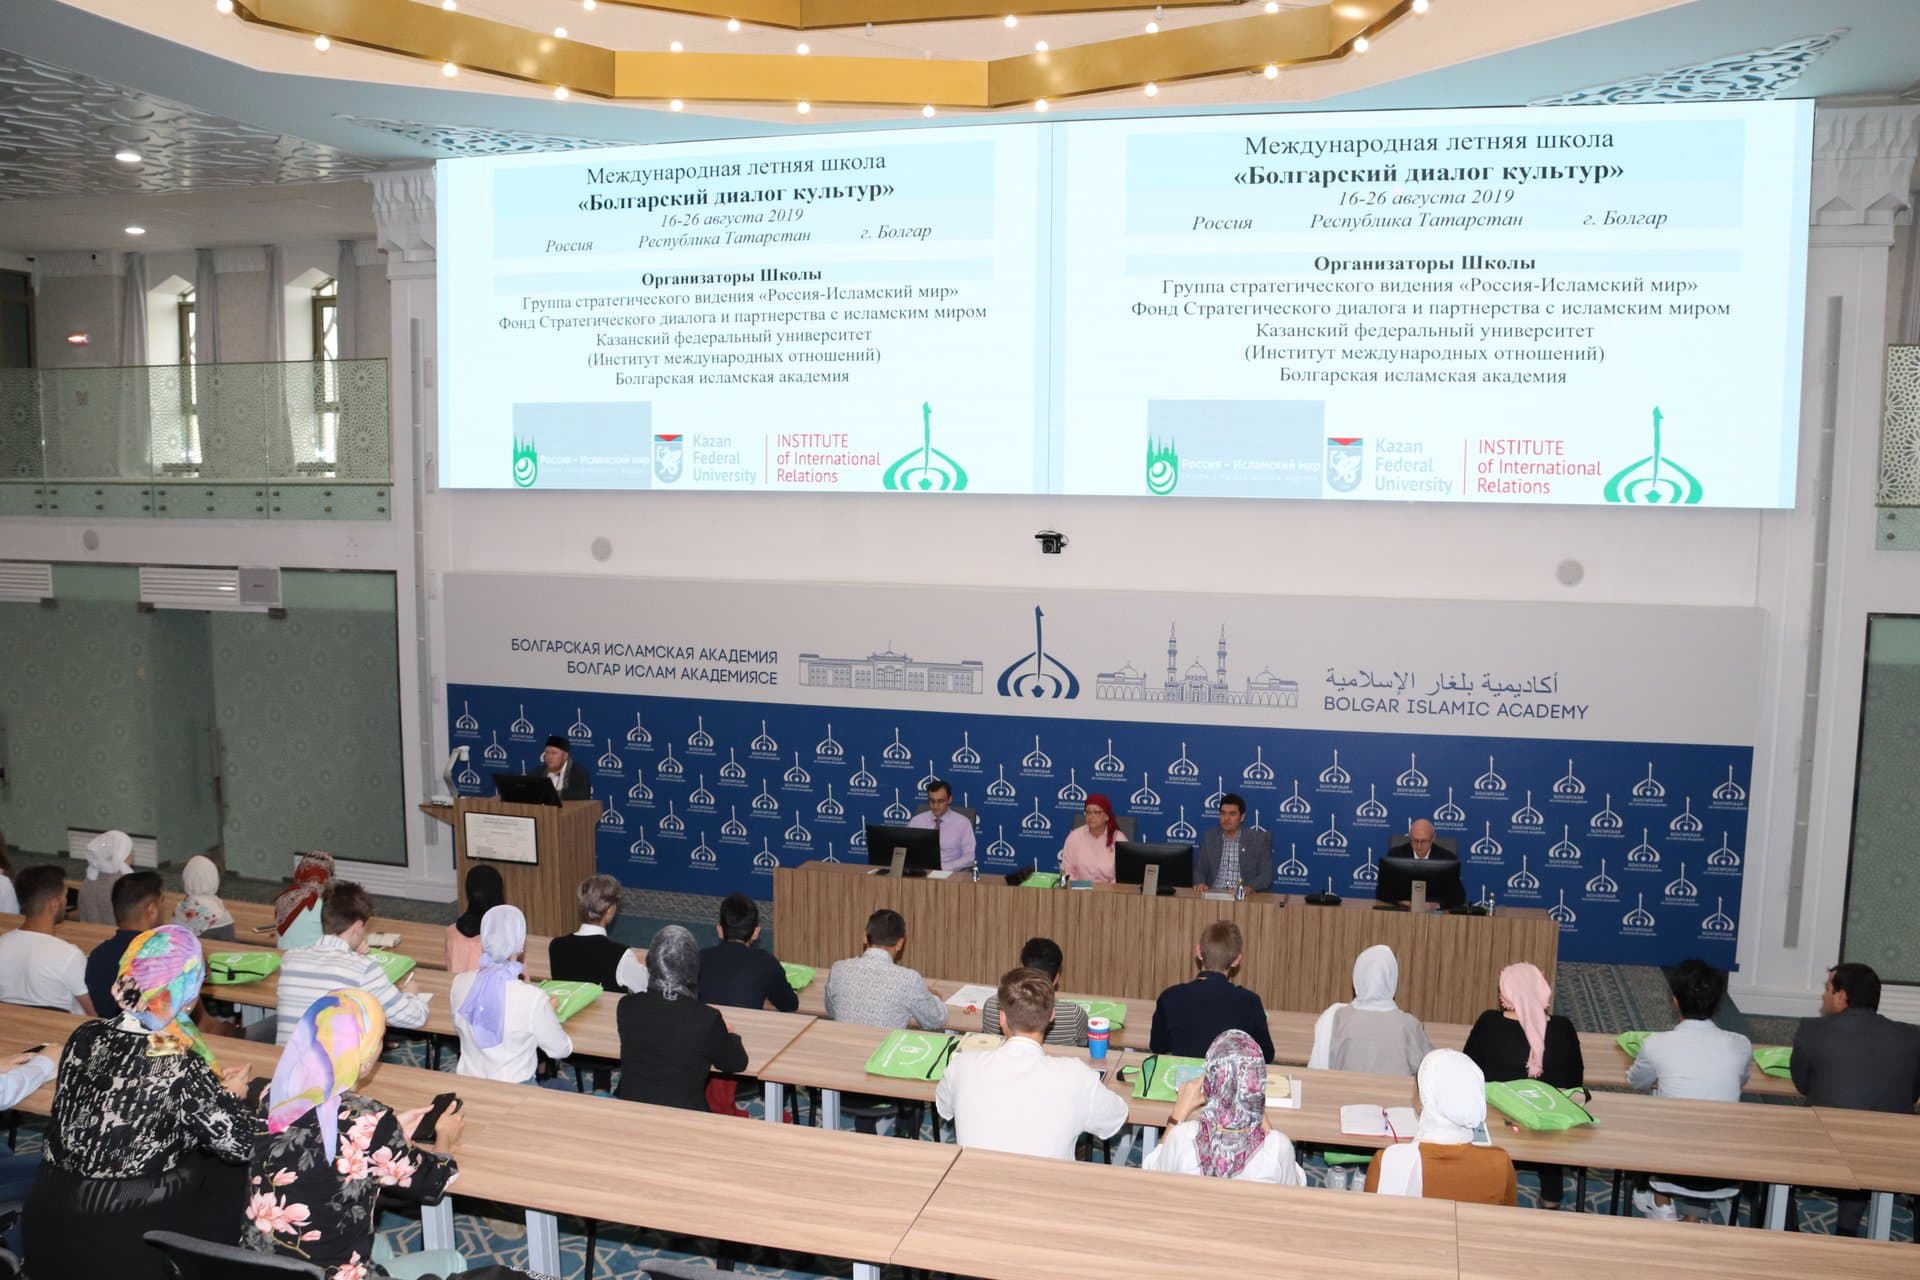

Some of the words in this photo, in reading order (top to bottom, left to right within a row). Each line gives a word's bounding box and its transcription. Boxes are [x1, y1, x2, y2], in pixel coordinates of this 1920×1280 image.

[1245, 136, 1438, 158] Международная
[1446, 134, 1527, 151] летняя
[1536, 133, 1615, 149] школа
[586, 164, 741, 185] Международная
[747, 159, 814, 175] летняя
[821, 155, 886, 172] школа
[1233, 164, 1397, 188] «Болгарский
[1405, 166, 1494, 183] диалог
[1502, 164, 1625, 184] культур»
[578, 189, 708, 212] «Болгарский
[714, 188, 786, 206] диалог
[793, 183, 895, 204] культур»
[1338, 191, 1387, 206] 16-26
[1392, 191, 1466, 208] августа
[1471, 189, 1515, 205] 2019
[660, 213, 700, 228] 16-26
[703, 212, 764, 228] августа
[768, 208, 804, 223] 2019
[1192, 216, 1253, 230] Россия
[1310, 213, 1412, 232] Республика
[1418, 212, 1523, 231] Татарстан
[1583, 214, 1596, 226] г.
[1603, 210, 1668, 229] Болгар
[545, 240, 594, 253] Россия
[638, 232, 720, 250] Республика
[725, 230, 811, 247] Татарстан
[860, 227, 873, 240] г.
[878, 225, 932, 240] Болгар
[1314, 256, 1454, 274] Организаторы
[1461, 255, 1536, 270] Школы
[642, 271, 755, 287] Организаторы
[760, 269, 822, 282] Школы
[1162, 280, 1224, 297] Группа
[1230, 281, 1374, 297] стратегического
[1380, 281, 1453, 293] видения
[1460, 277, 1644, 293] «Россия-Исламский
[1650, 279, 1698, 296] мир»
[523, 297, 572, 312] Группа
[575, 294, 690, 310] стратегического
[695, 292, 754, 304] видения
[760, 285, 913, 302] «Россия-Исламский
[918, 286, 959, 302] мир»
[498, 317, 535, 330] Фонд
[539, 314, 656, 331] Стратегического
[660, 314, 716, 327] диалога
[721, 313, 730, 323] и
[735, 310, 826, 326] партнерства
[830, 311, 838, 321] с
[844, 308, 929, 320] исламским
[934, 307, 987, 322] миром
[1131, 301, 1178, 317] Фонд
[1183, 301, 1332, 319] Стратегического
[1336, 303, 1407, 316] диалога
[1412, 304, 1423, 315] и
[1429, 303, 1540, 319] партнерства
[1545, 304, 1555, 315] с
[1561, 303, 1662, 315] исламским
[1669, 303, 1731, 319] миром
[596, 331, 670, 347] Казанский
[674, 330, 772, 348] федеральный
[776, 329, 873, 346] университет
[1256, 322, 1348, 338] Казанский
[1354, 323, 1474, 341] федеральный
[1480, 325, 1595, 341] университет
[588, 352, 660, 368] (Институт
[664, 351, 784, 367] международных
[788, 348, 881, 364] отношений)
[1245, 345, 1335, 363] (Институт
[1341, 348, 1488, 364] международных
[1494, 345, 1605, 364] отношений)
[615, 372, 695, 387] Болгарская
[699, 371, 774, 385] исламская
[779, 370, 849, 384] академия
[1280, 368, 1378, 386] Болгарская
[1384, 370, 1476, 383] исламская
[1482, 370, 1567, 384] академия
[693, 434, 732, 448] Kazan
[777, 433, 849, 448] INSTITUTE
[1376, 437, 1423, 454] Kazan
[1479, 438, 1564, 456] INSTITUTE
[693, 451, 741, 465] Federal
[777, 450, 791, 465] of
[794, 451, 881, 466] International
[1376, 456, 1433, 473] Federal
[1478, 458, 1495, 475] of
[1498, 458, 1601, 477] International
[693, 468, 757, 485] University
[777, 469, 838, 484] Relations
[1375, 475, 1453, 495] University
[1477, 477, 1550, 495] Relations
[511, 639, 600, 654] БОЛГАРСКАЯ
[605, 643, 694, 660] ИСЛАМСКАЯ
[699, 648, 778, 664] АКАДЕМИЯ
[567, 661, 620, 676] БОЛГАР
[626, 664, 676, 679] ИСЛАМ
[680, 668, 778, 685] АКАДЕМИЯСЕ
[1325, 667, 1415, 696] الإسلامية
[1424, 672, 1474, 696] بلغار
[1481, 672, 1558, 698] أكاديمية
[1324, 696, 1400, 713] BOLGAR
[1407, 699, 1490, 716] ISLAMIC
[1496, 703, 1589, 720] ACADEMY
